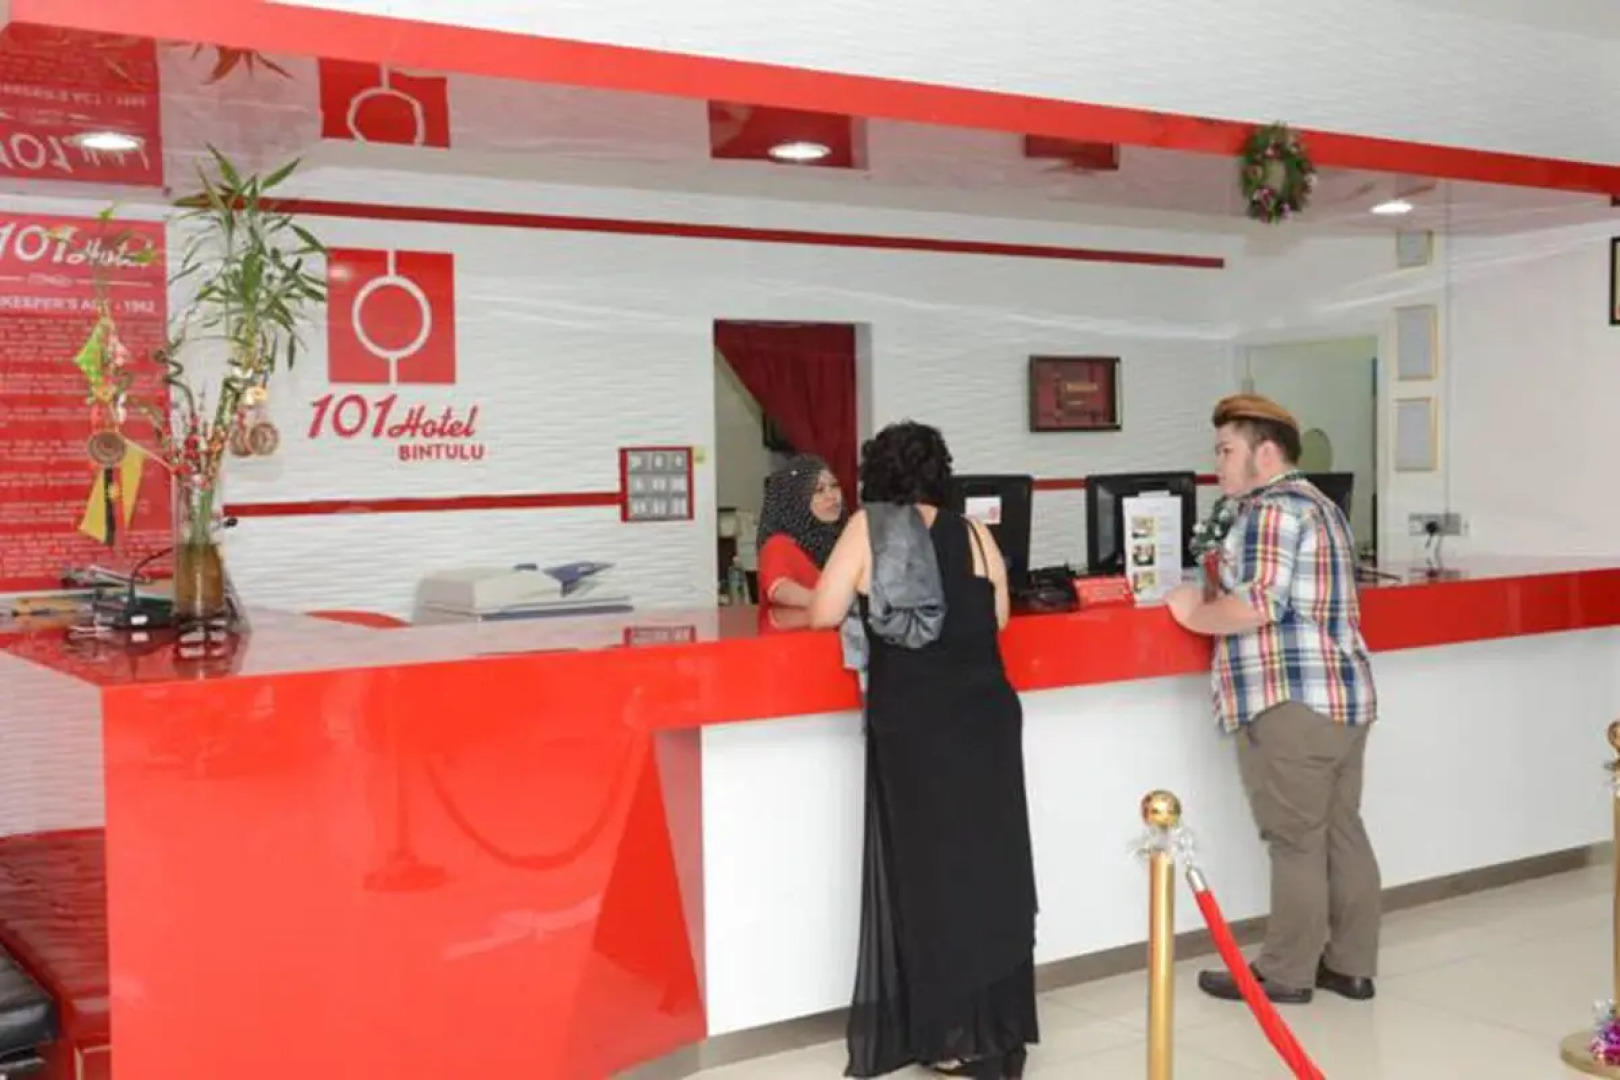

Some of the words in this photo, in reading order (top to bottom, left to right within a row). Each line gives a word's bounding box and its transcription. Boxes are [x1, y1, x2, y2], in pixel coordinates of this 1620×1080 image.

[308, 393, 397, 439] 101
[387, 405, 478, 438] Hotel
[398, 443, 485, 461] BINTULU
